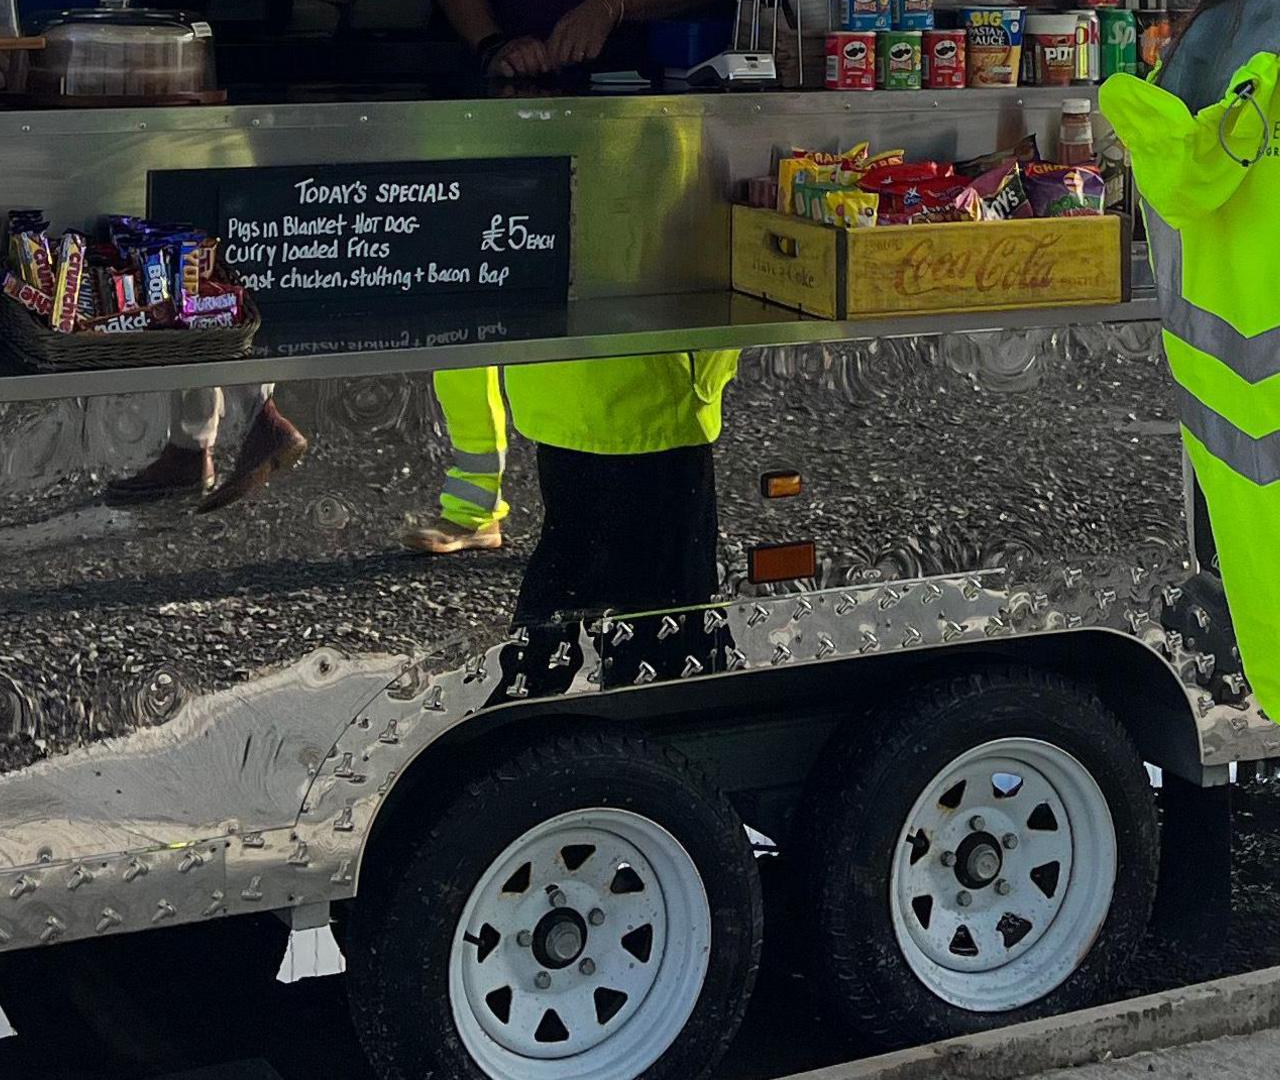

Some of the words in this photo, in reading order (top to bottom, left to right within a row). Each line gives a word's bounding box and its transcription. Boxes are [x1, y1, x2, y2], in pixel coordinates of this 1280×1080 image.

[970, 12, 1002, 27] BIG
[375, 181, 461, 204] SPECIALS
[228, 218, 260, 241] Pigs
[263, 220, 278, 237] in
[283, 216, 348, 236] Blanket
[351, 213, 379, 234] HOT
[384, 216, 420, 234] DOG
[526, 233, 555, 251] EACH
[236, 270, 276, 292] oast
[427, 263, 470, 283] Bacon
[479, 264, 510, 287] Bap
